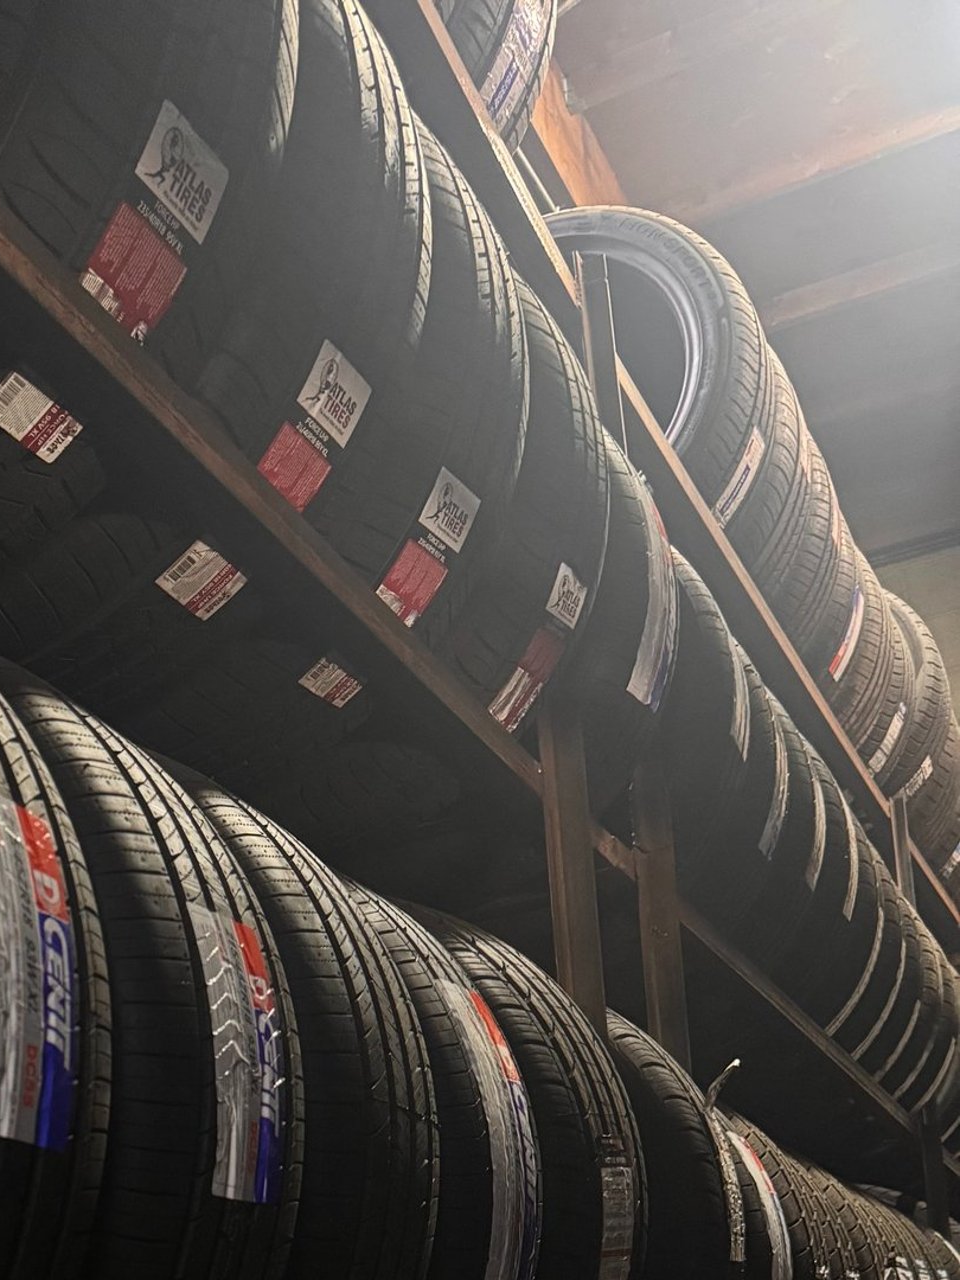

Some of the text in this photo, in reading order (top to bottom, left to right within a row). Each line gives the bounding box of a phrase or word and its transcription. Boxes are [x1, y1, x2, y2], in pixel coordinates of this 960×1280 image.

[169, 172, 207, 224] TIRES
[174, 158, 212, 208] ATLAS
[323, 395, 352, 430] TIRES
[330, 382, 357, 416] ATLAS
[439, 512, 464, 538] TIRES
[445, 500, 469, 526] ATLAS
